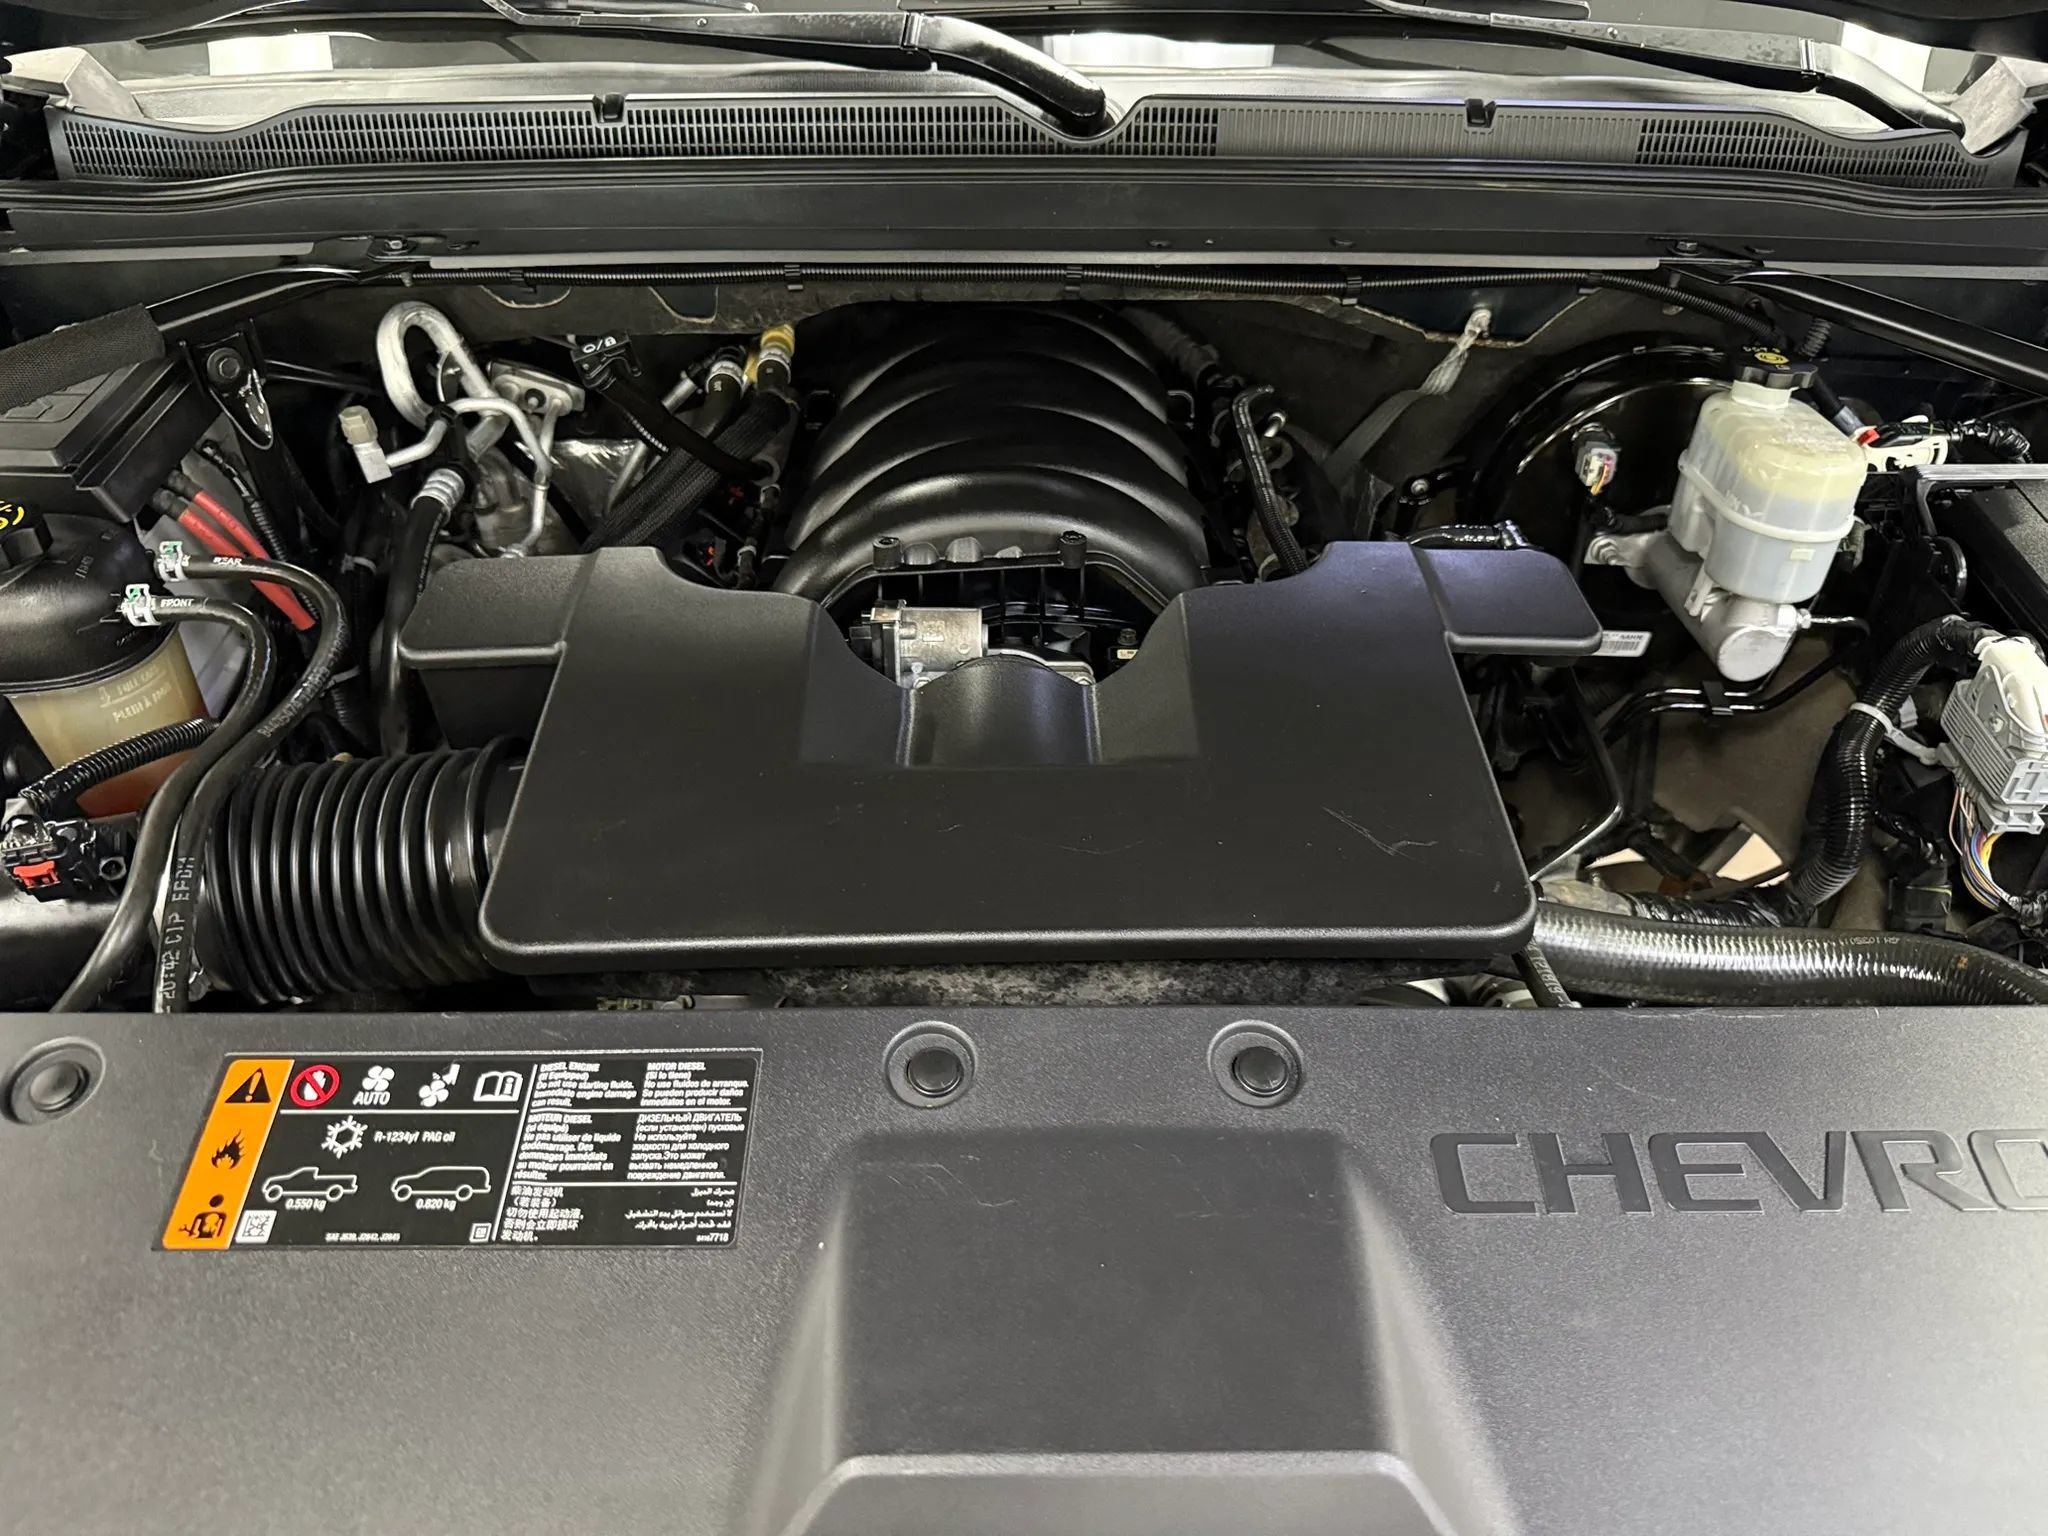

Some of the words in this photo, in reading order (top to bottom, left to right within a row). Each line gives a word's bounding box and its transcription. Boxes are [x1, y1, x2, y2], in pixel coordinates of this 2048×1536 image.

[213, 556, 242, 566] REAR
[160, 598, 195, 608] FRONT
[172, 857, 196, 901] EPDM
[165, 912, 186, 945] CIP
[540, 1062, 567, 1072] DIESEL
[568, 1062, 600, 1072] ENGINE
[647, 1062, 677, 1070] MOTOR
[678, 1062, 706, 1070] DIESEL
[578, 1081, 609, 1090] starting
[673, 1080, 699, 1088] fluidos
[576, 1090, 603, 1099] engine
[604, 1090, 637, 1099] damage
[642, 1089, 653, 1097] Se
[654, 1089, 684, 1098] pueden
[685, 1089, 718, 1098] producir
[719, 1088, 744, 1096] daños
[353, 1092, 391, 1105] AUTO
[532, 1099, 546, 1107] can
[686, 1098, 696, 1106] en
[528, 1113, 562, 1123] MOTEUR
[563, 1114, 592, 1123] DIESEL
[637, 1113, 691, 1124] ДИЗЕЛЬНЫЙ
[692, 1113, 742, 1123] ДВИГАТЕЛЬ
[374, 1131, 419, 1144] R-1234yf
[422, 1132, 442, 1142] PAG
[443, 1131, 456, 1142] oil
[523, 1133, 535, 1141] Ne
[535, 1133, 551, 1142] pas
[581, 1133, 592, 1142] de
[593, 1133, 622, 1143] liquide
[634, 1133, 646, 1141] Не
[577, 1143, 594, 1151] Des
[688, 1143, 729, 1151] холодного
[528, 1161, 558, 1170] moteur
[602, 1162, 614, 1170] en
[285, 1199, 312, 1209] 0.550
[313, 1199, 327, 1212] kg
[443, 1199, 457, 1211] kg
